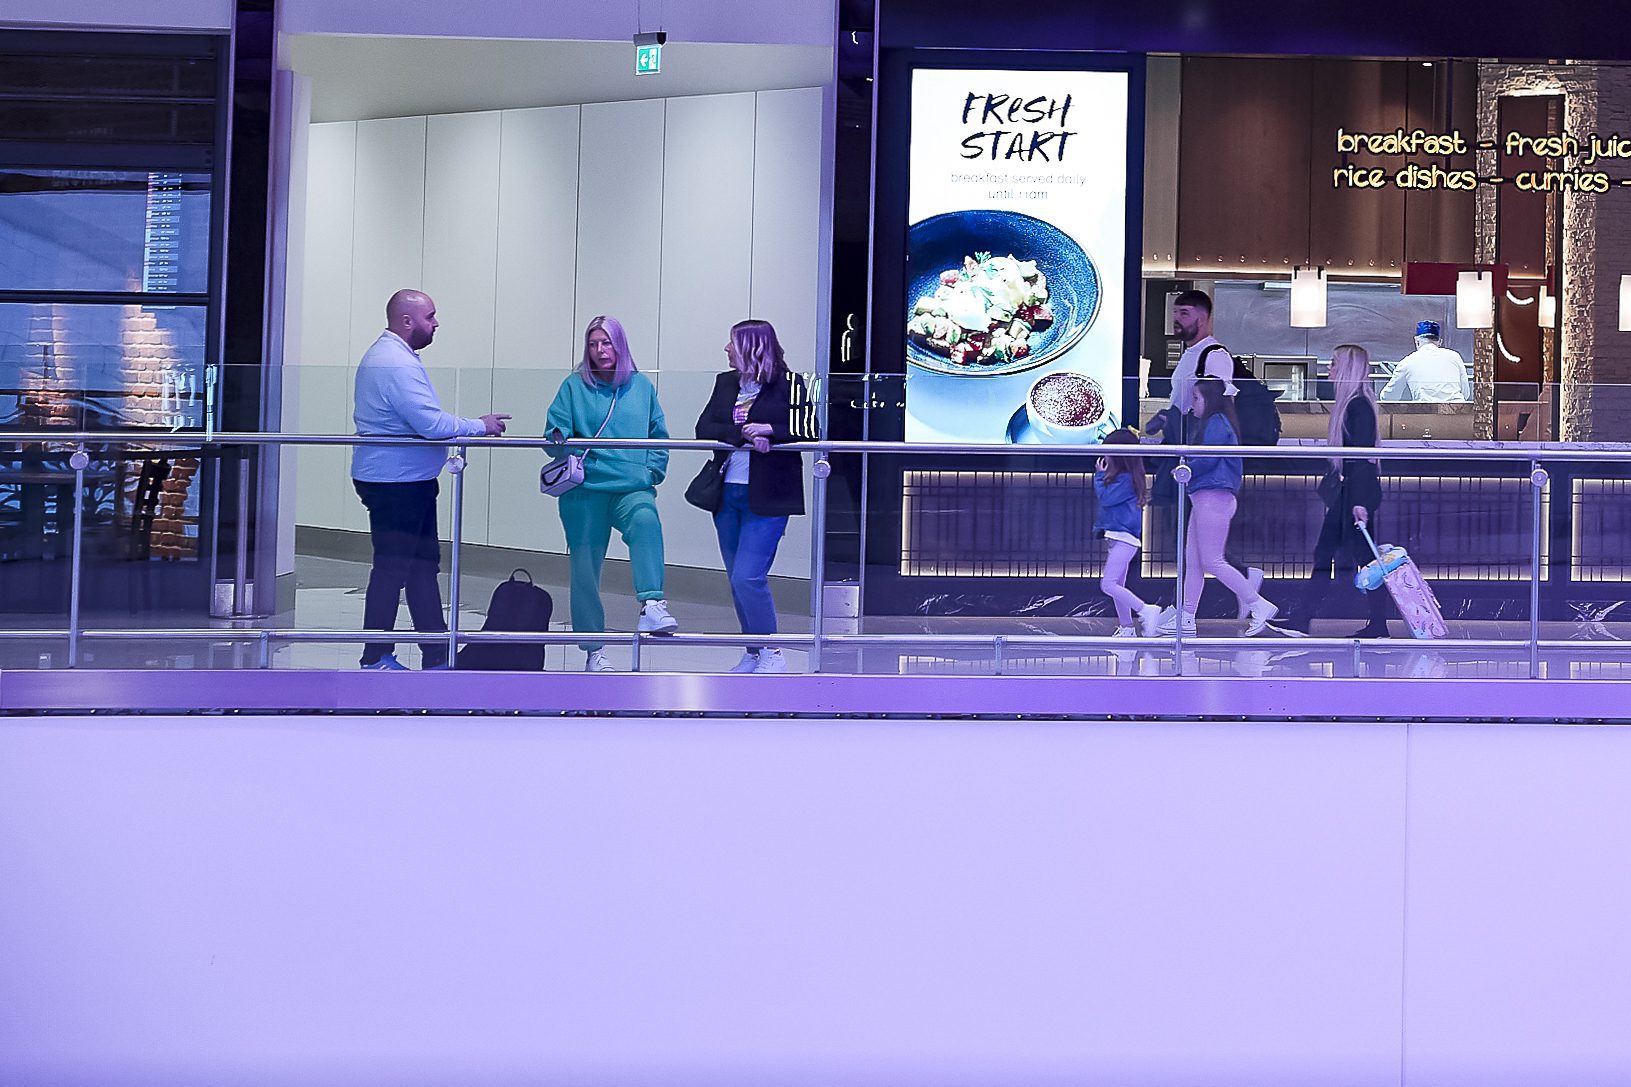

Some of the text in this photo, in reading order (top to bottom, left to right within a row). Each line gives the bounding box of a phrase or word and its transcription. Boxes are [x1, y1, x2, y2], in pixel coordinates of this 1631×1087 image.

[960, 130, 1078, 162] START
[1337, 128, 1467, 154] breakfast
[1505, 131, 1577, 156] fresh
[951, 172, 1008, 185] breakfast
[1012, 174, 1053, 185] served
[1333, 164, 1386, 188] rice
[1395, 164, 1477, 190] dishes
[1515, 168, 1610, 193] curries
